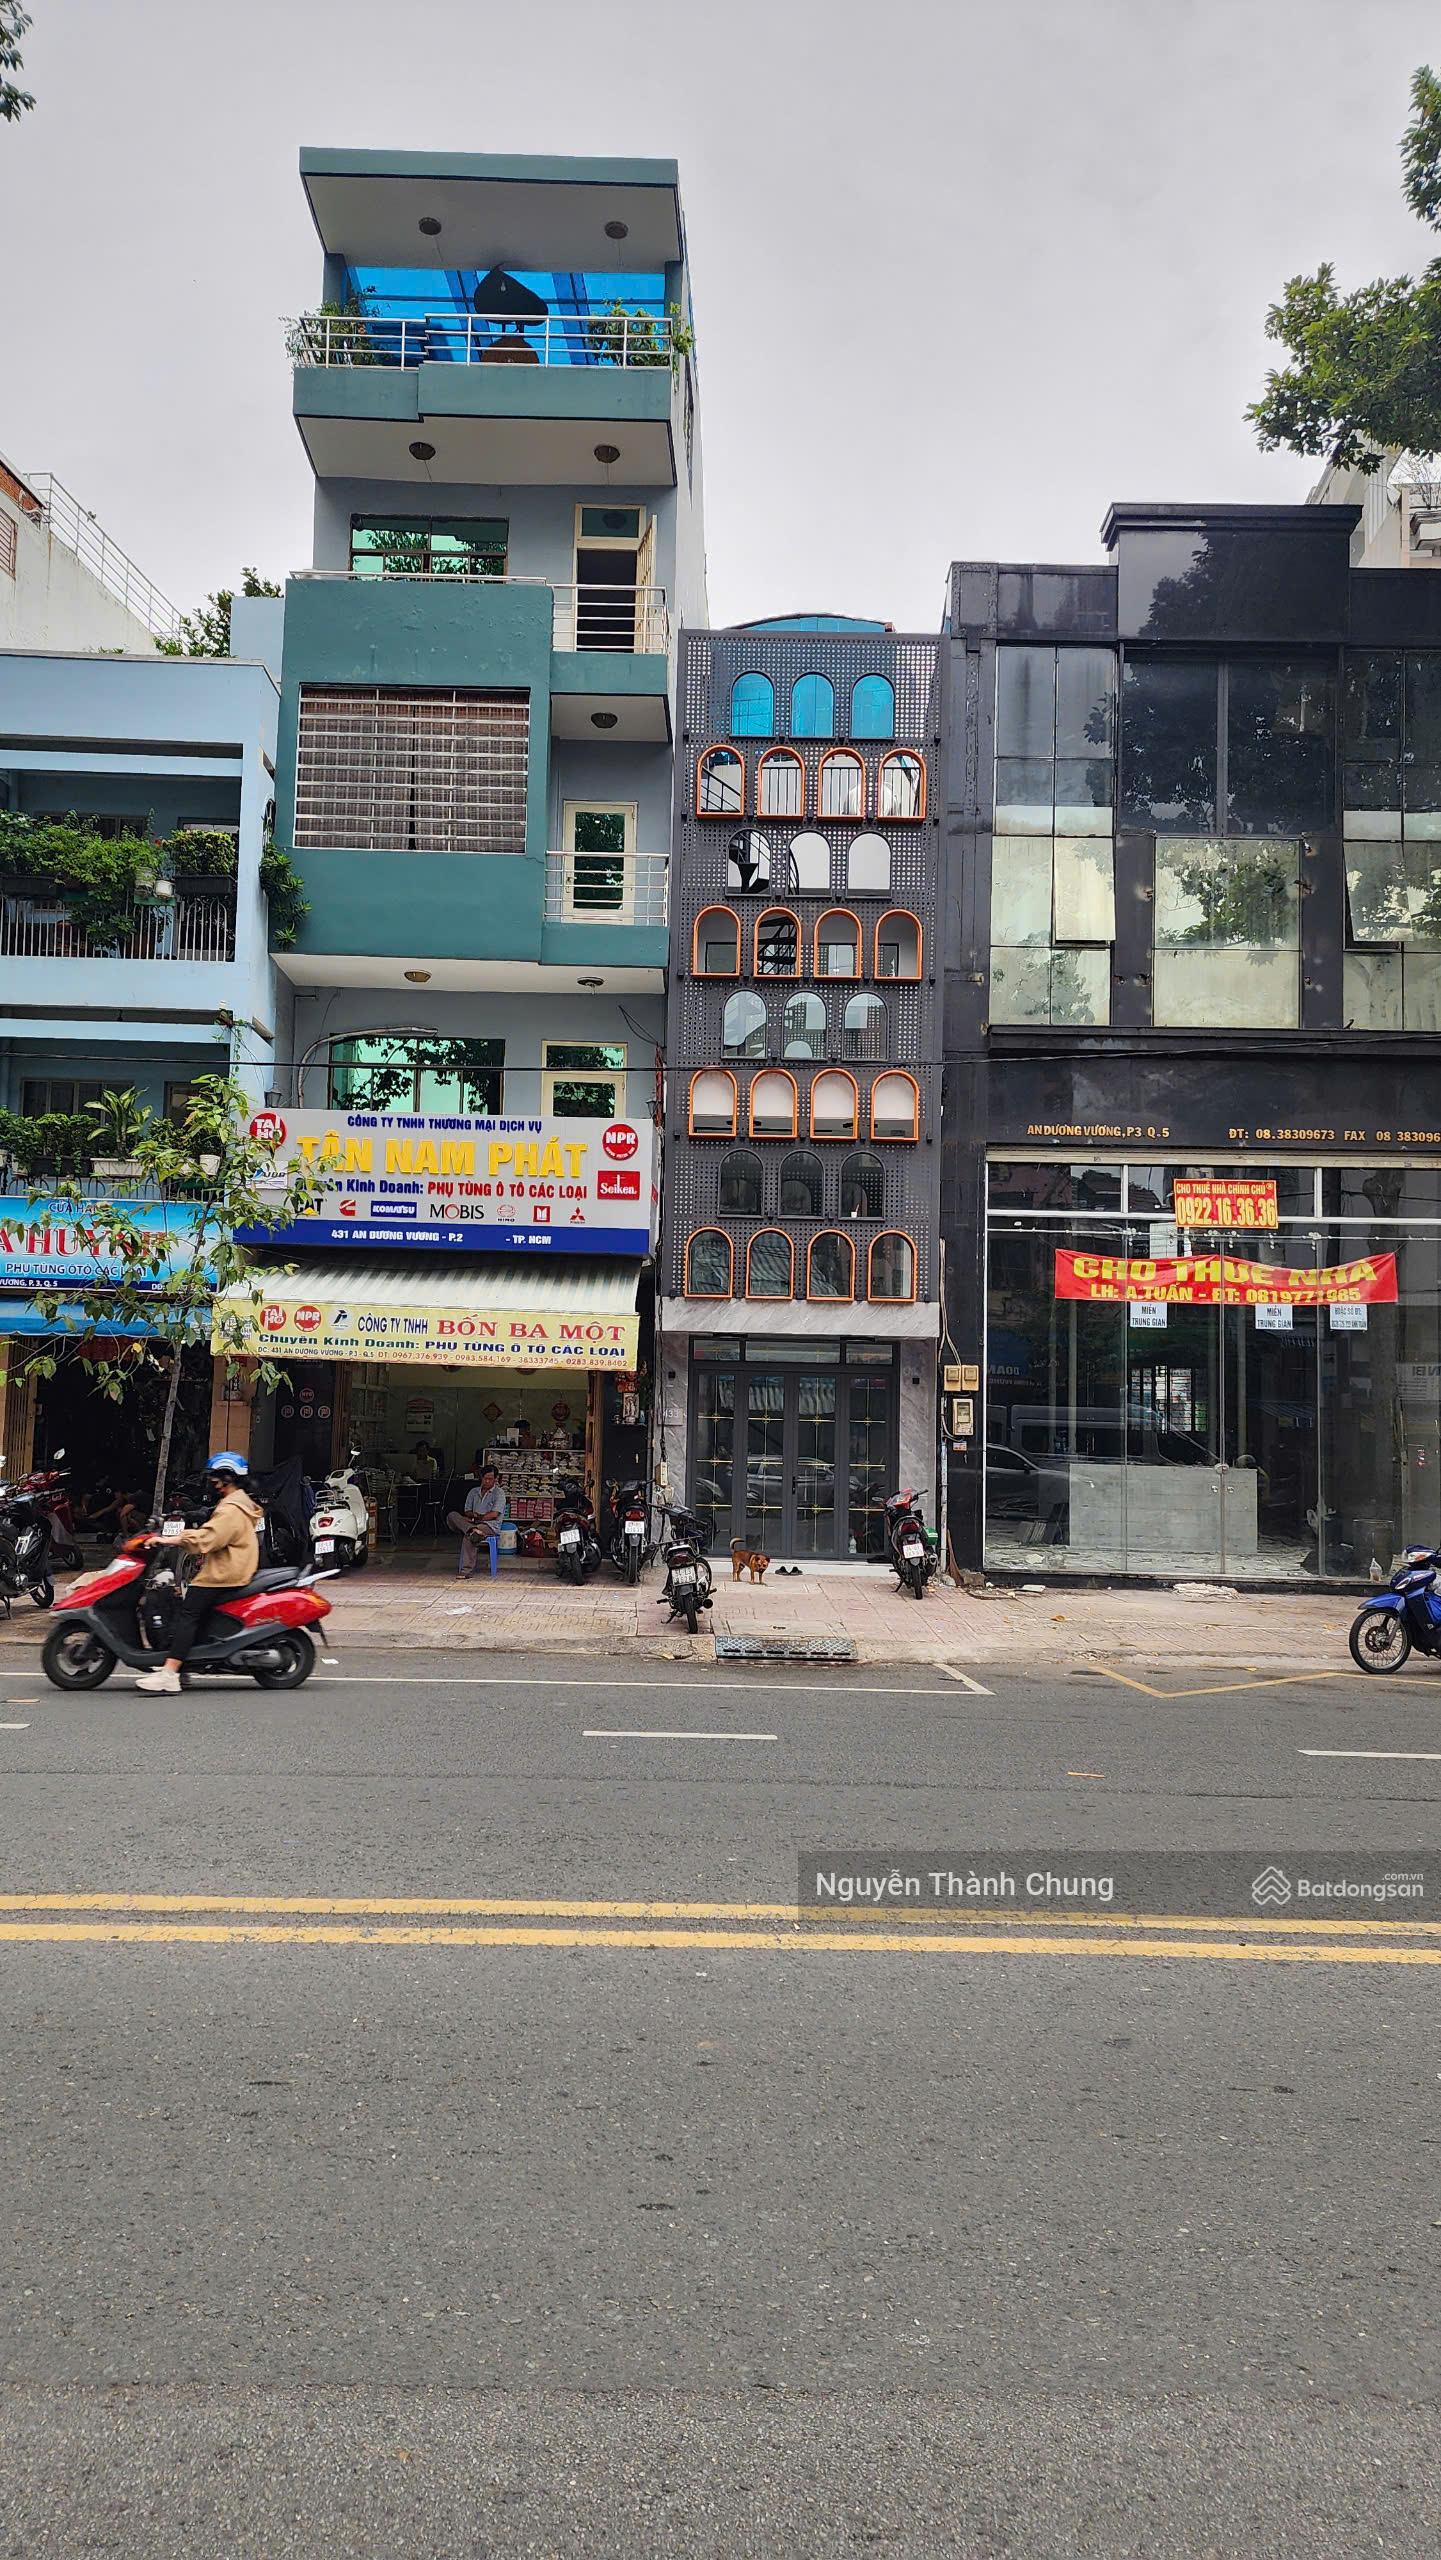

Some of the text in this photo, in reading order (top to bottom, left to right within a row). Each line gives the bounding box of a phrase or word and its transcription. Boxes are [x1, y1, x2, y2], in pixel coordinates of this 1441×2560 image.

[347, 1114, 542, 1134] CÔNG TY TNHH THƯƠNG MẠI DỊCH VỤ
[605, 1131, 636, 1145] NPR
[1027, 1125, 1043, 1136] AN
[1229, 1128, 1249, 1139] ĐT:
[1255, 1129, 1335, 1141] 08.38309673
[1344, 1130, 1366, 1141] FAX
[1376, 1131, 1391, 1142] 08
[296, 1129, 588, 1178] TÂN NAM PHÁT
[295, 1177, 342, 1194] Cên
[347, 1179, 375, 1193] Kinh
[379, 1180, 424, 1195] Doanh:
[427, 1181, 454, 1198] PHỤ
[458, 1180, 492, 1197] TÙNG
[496, 1181, 505, 1197] Ô
[509, 1183, 525, 1198] TÔ
[528, 1182, 555, 1199] CÁC
[559, 1186, 588, 1200] LOẠI
[600, 1174, 634, 1195] Seiken
[1176, 1182, 1266, 1195] CHO THUÊ NHÀ CHÍNH CHỦ
[371, 1204, 416, 1215] KOMATSU
[429, 1203, 485, 1220] MOBIS
[1176, 1197, 1275, 1226] 0922.16.36.36
[331, 1229, 349, 1239] 431
[352, 1230, 367, 1240] AN
[369, 1230, 403, 1241] DƯƠNG
[406, 1231, 440, 1242] VƯƠNG
[448, 1233, 464, 1242] P.2
[512, 1235, 527, 1244] TP.
[528, 1236, 552, 1245] HCM
[6, 1263, 31, 1276] PHỤ
[33, 1263, 65, 1275] TÙNG
[95, 1265, 118, 1276] CÁC
[1073, 1257, 1156, 1282] CHO
[43, 1280, 52, 1288] Q.
[1090, 1284, 1118, 1299] LH:
[1212, 1288, 1240, 1302] ĐT:
[1246, 1287, 1361, 1303] 0819771985
[296, 1311, 320, 1320] NPR
[1132, 1317, 1166, 1327] TRUNG GIAN
[1257, 1319, 1292, 1328] TRUNG GIAN
[357, 1313, 626, 1343] CÔNG TY TNHH BỐN BA MỘT
[259, 1334, 317, 1345] Chuyên
[365, 1339, 420, 1349] Doanh:
[425, 1341, 458, 1352] PHỤ
[463, 1341, 505, 1352] TÙNG
[511, 1344, 521, 1353] Ô
[527, 1345, 546, 1354] TÔ
[551, 1344, 584, 1355] CÁC
[589, 1347, 625, 1358] LOẠI
[392, 1351, 448, 1361] 0967.376.939
